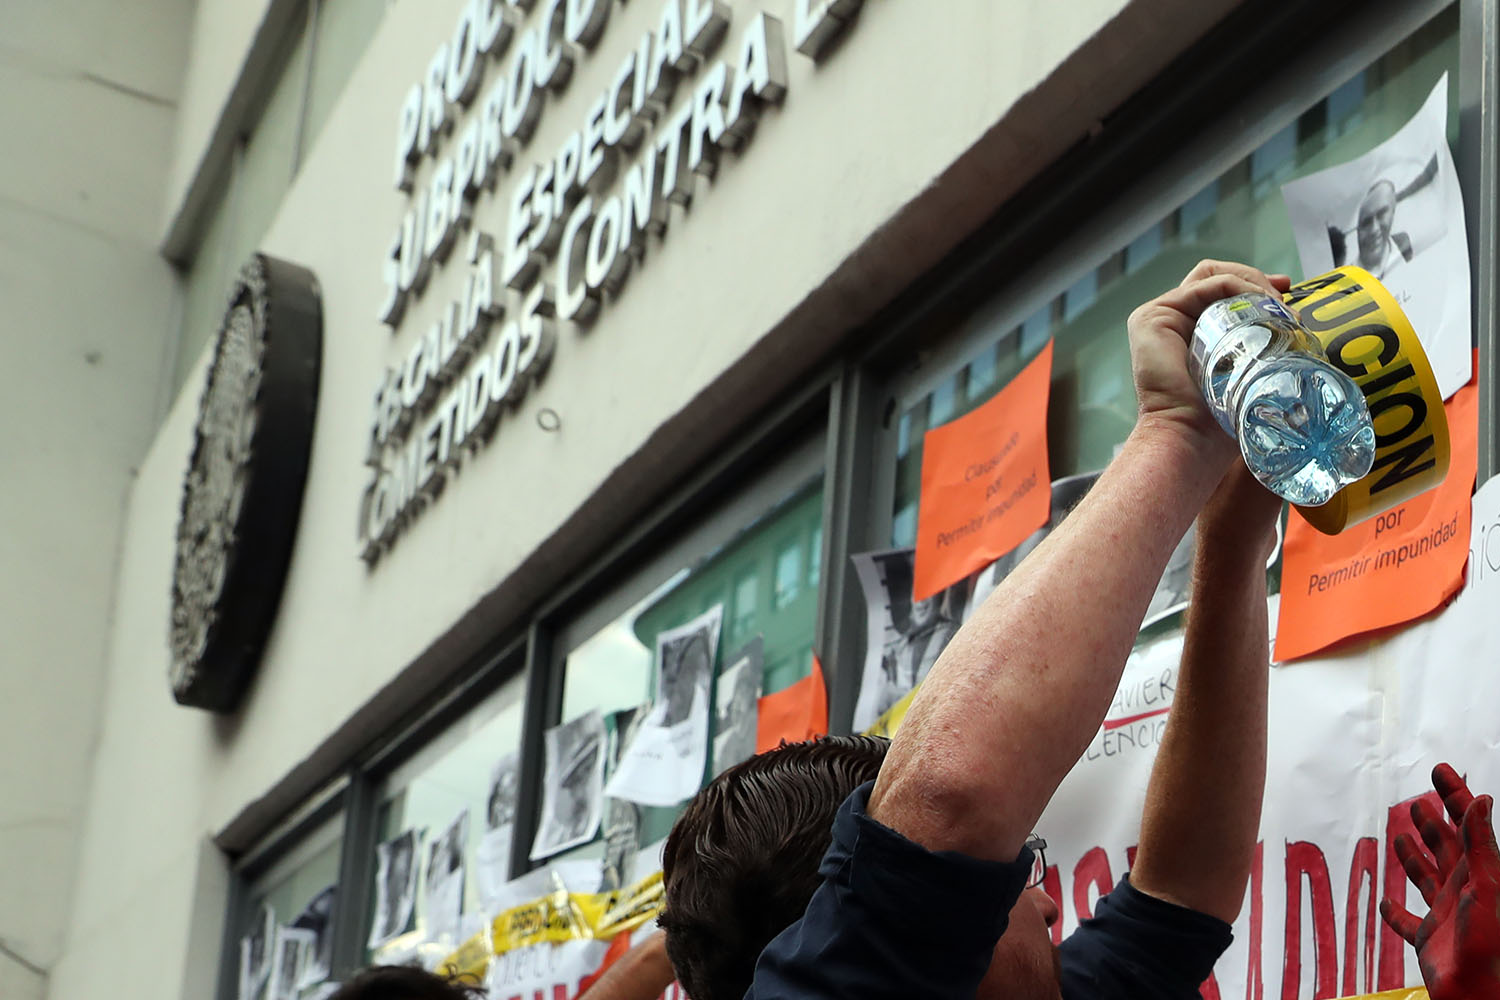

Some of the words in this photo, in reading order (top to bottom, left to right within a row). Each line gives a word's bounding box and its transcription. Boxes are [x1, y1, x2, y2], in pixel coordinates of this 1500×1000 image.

[555, 10, 772, 320] CONTRA
[1308, 556, 1372, 596] Permitir
[1374, 511, 1458, 571] impunidad
[1374, 507, 1406, 539] por
